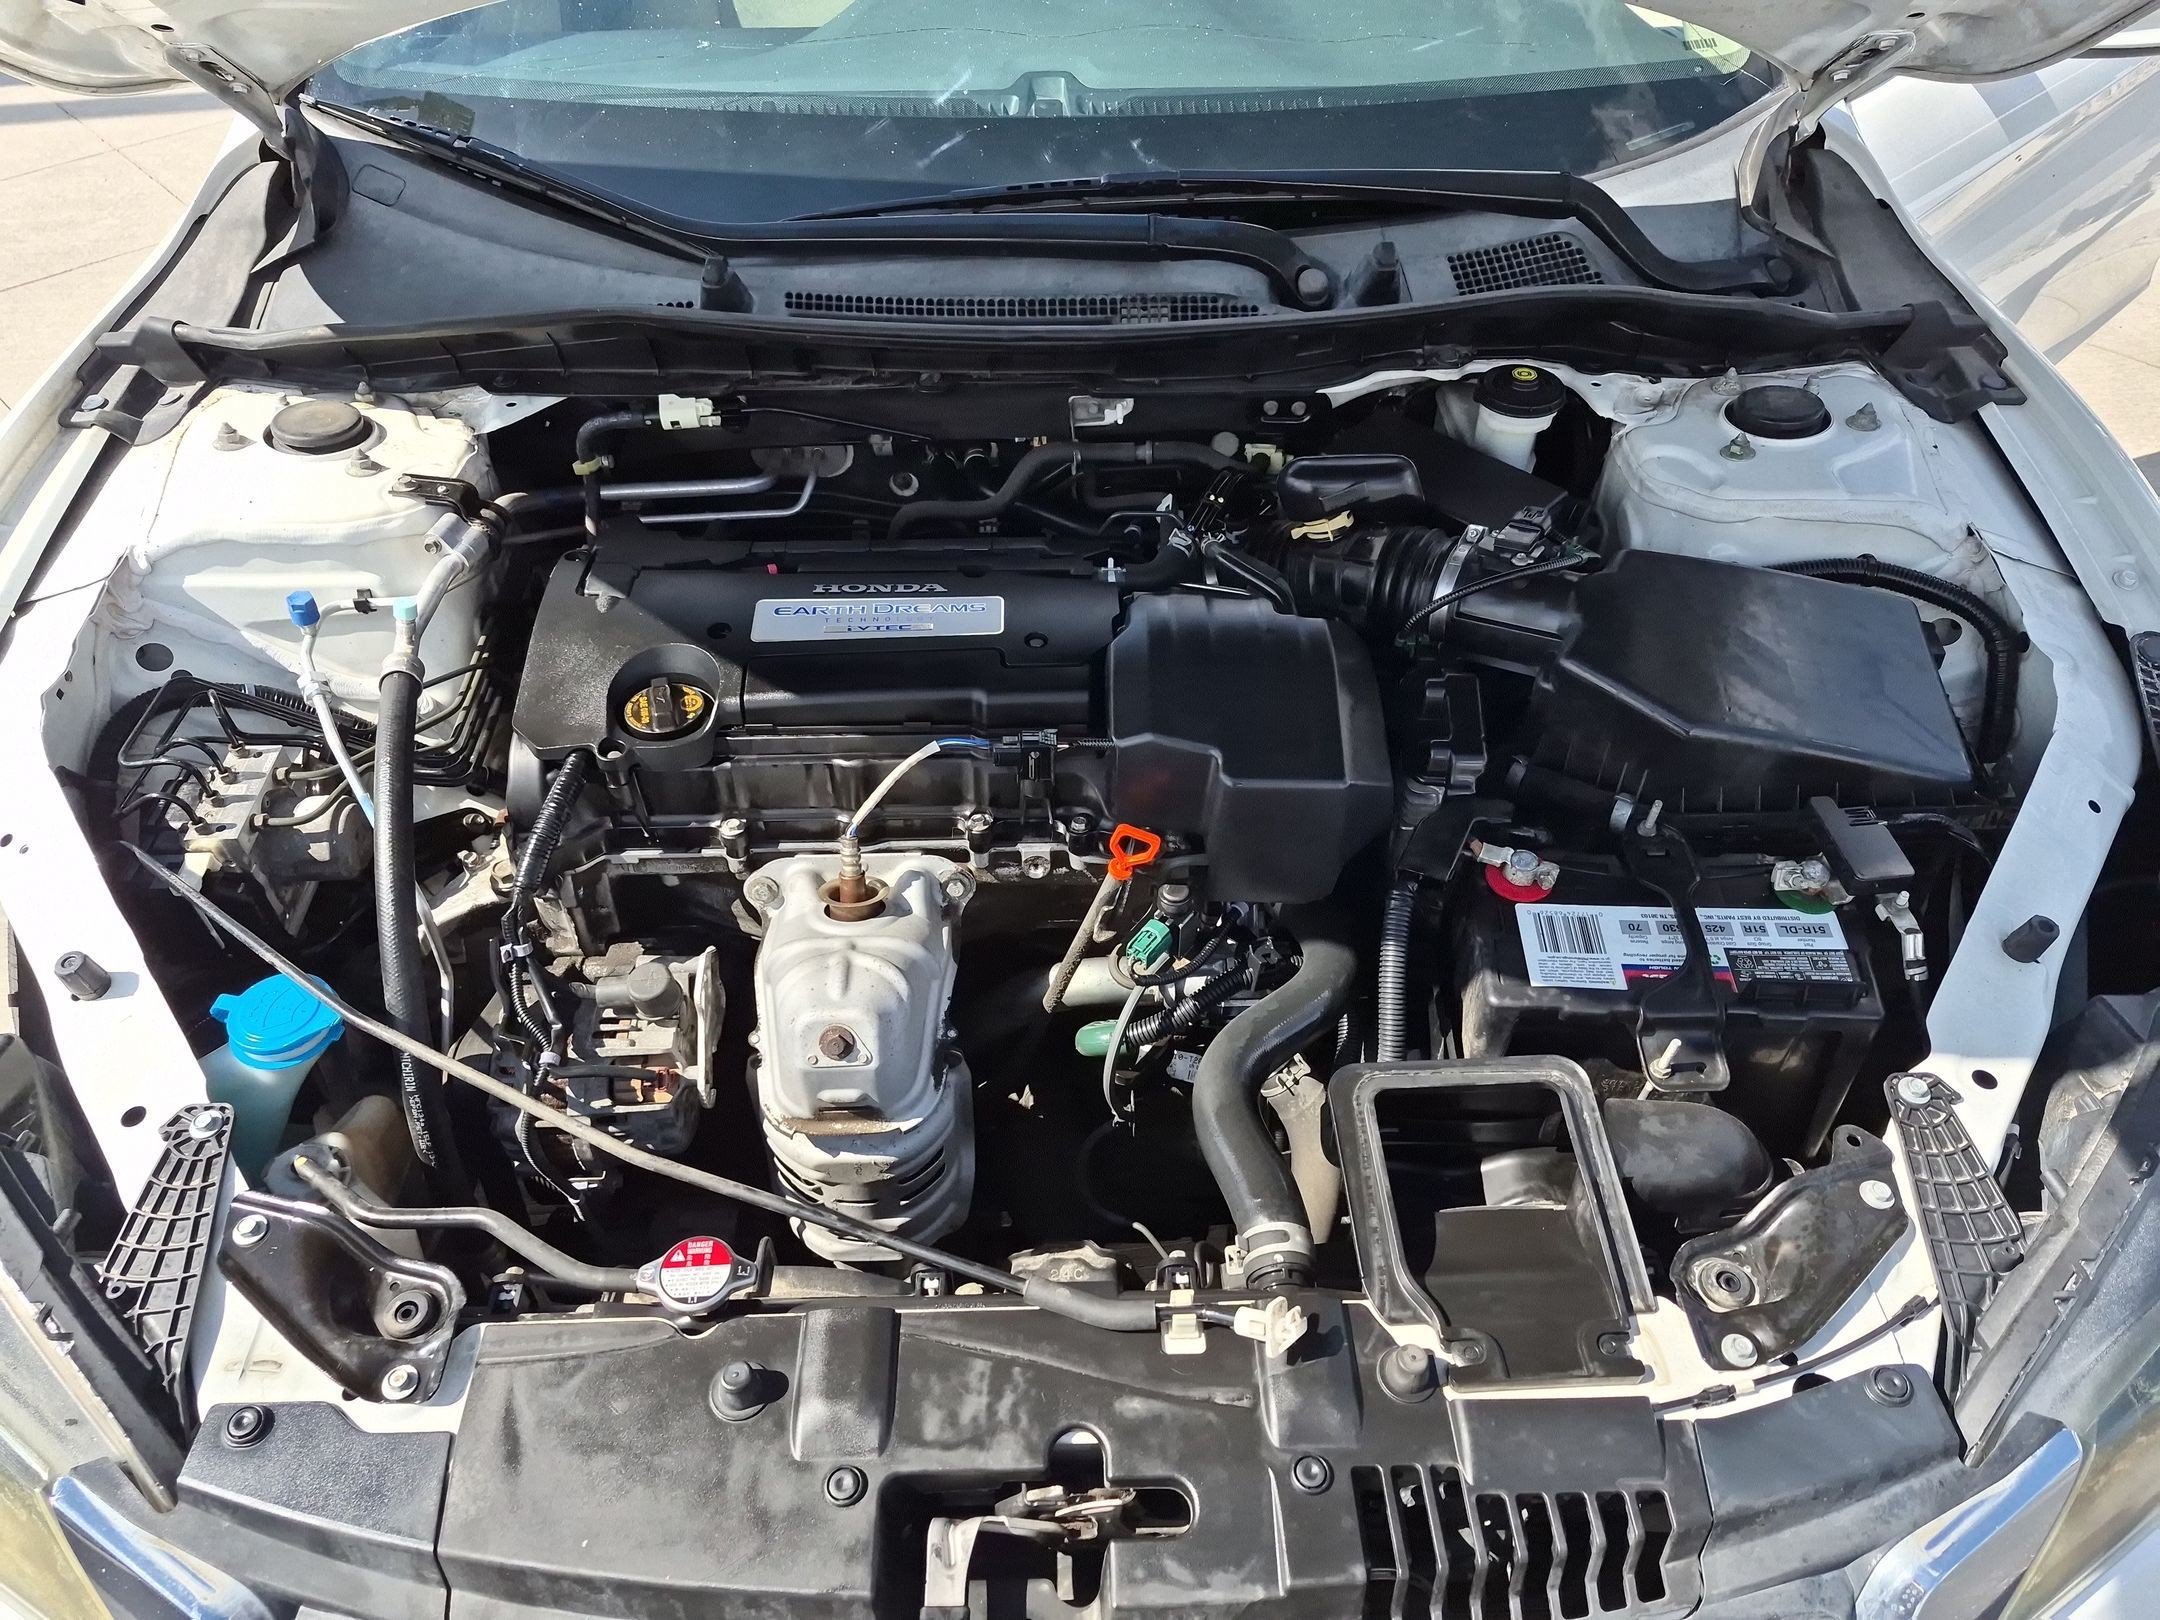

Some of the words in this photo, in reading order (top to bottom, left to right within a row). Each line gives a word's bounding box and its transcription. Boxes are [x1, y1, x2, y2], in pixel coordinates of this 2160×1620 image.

[813, 583, 947, 593] HONDA
[773, 605, 866, 616] EARTH
[872, 602, 986, 615] DREAMS
[1628, 923, 1643, 932] 70
[1705, 923, 1726, 933] 425
[1744, 924, 1766, 934] 51R
[1780, 925, 1826, 935] 51R-DL
[687, 1240, 714, 1248] DANGER
